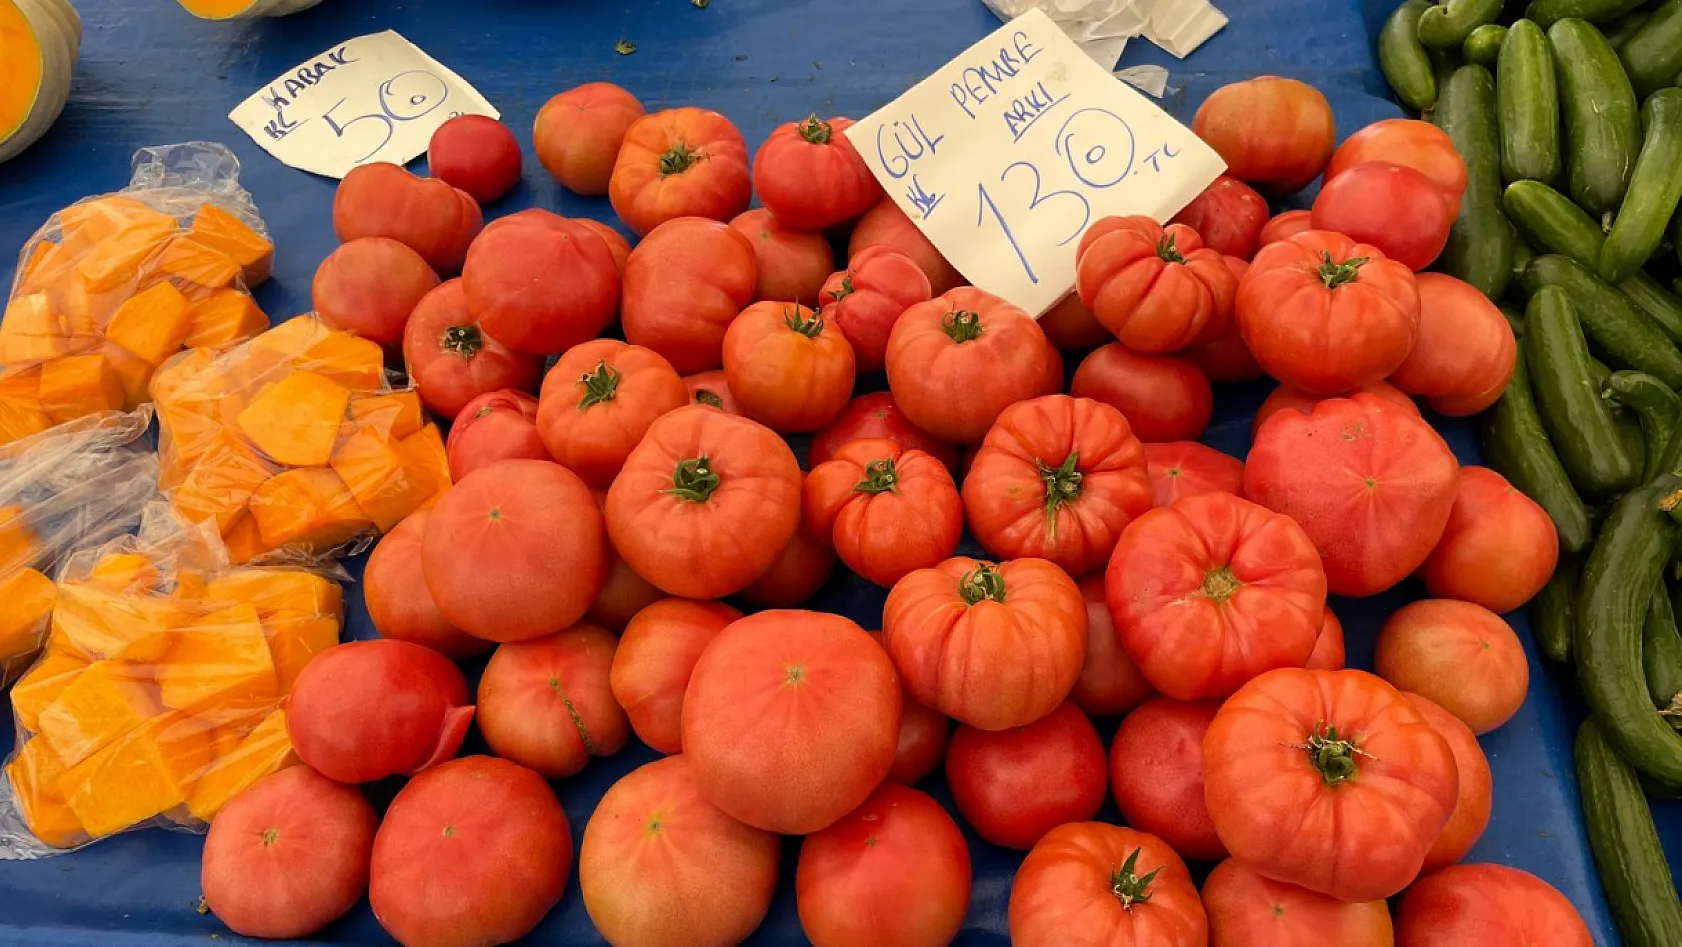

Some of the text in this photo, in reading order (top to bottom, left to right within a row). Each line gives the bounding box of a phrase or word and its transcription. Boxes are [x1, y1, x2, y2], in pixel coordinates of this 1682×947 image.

[261, 46, 361, 111] KABAK
[321, 69, 449, 163] 50
[876, 30, 1045, 179] GÜL PEMBE
[977, 107, 1136, 285] 130
